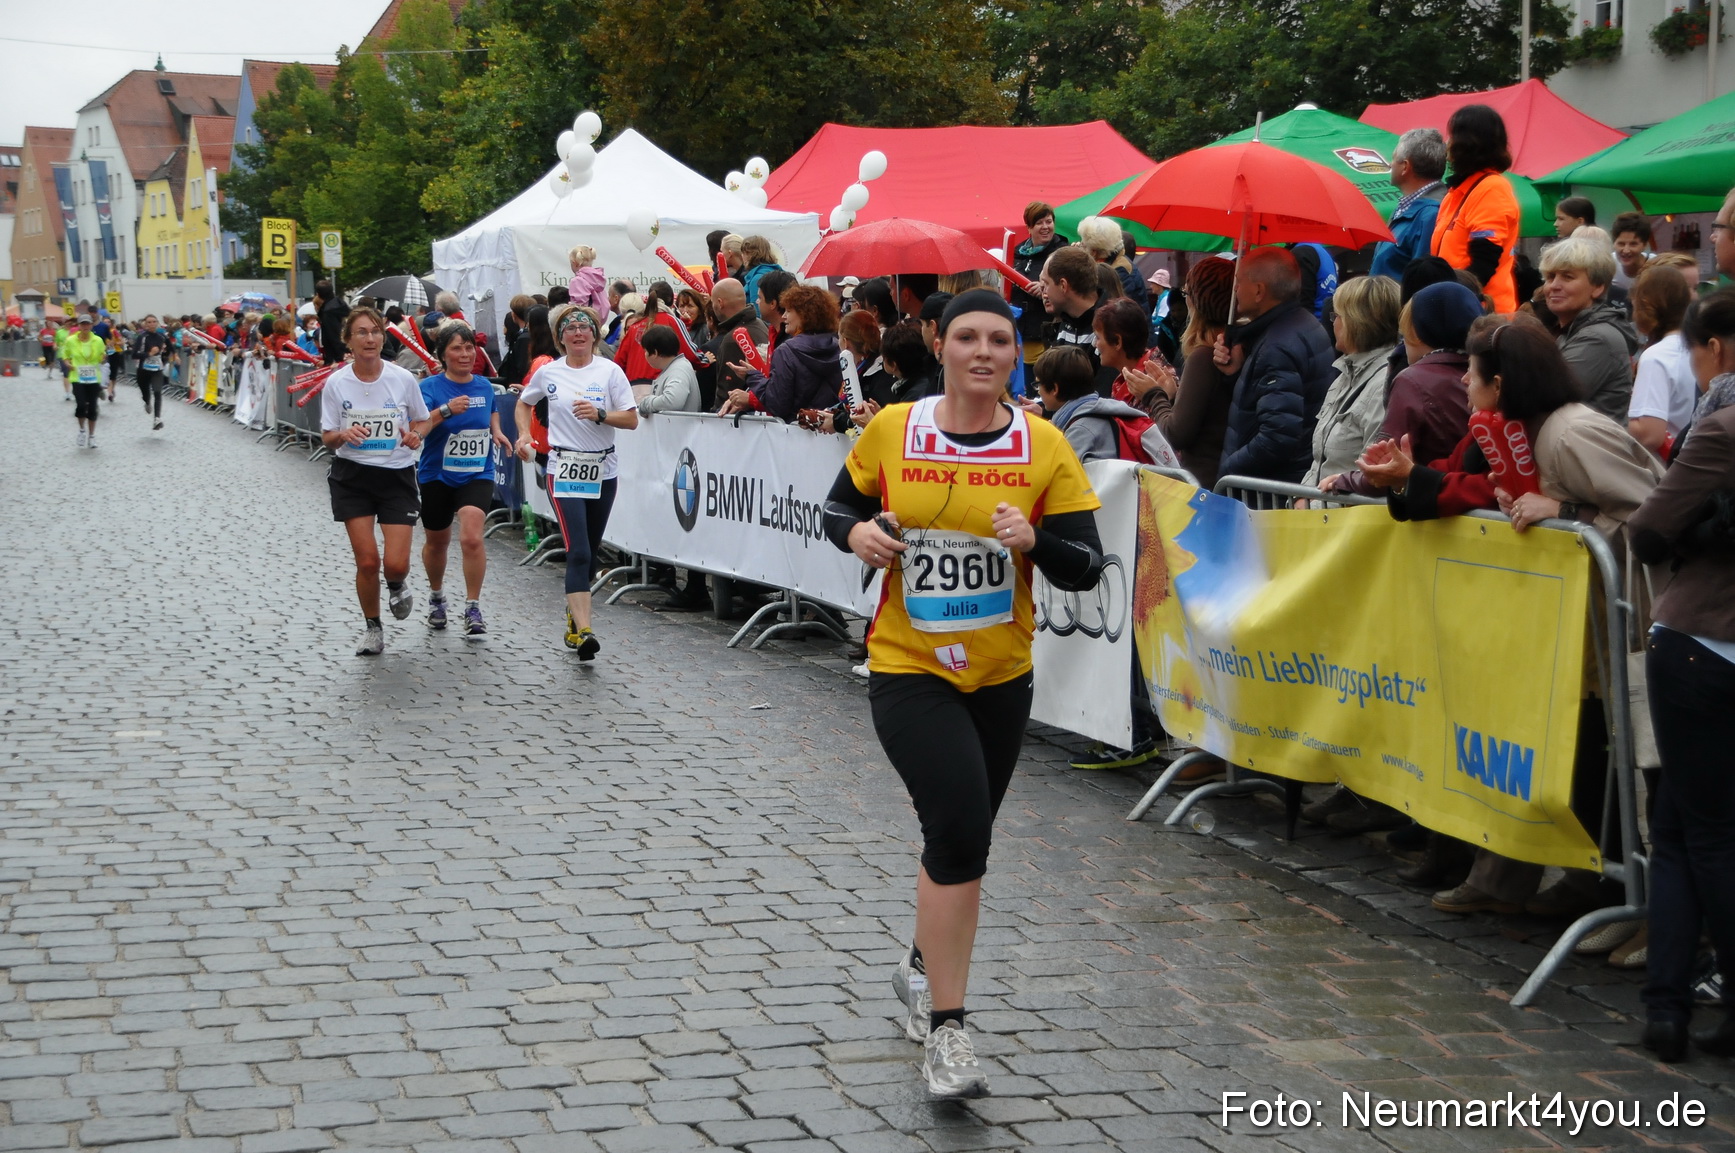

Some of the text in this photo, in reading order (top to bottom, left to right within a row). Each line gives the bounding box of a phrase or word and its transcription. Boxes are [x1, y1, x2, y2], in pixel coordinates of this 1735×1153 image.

[266, 221, 292, 230] Block
[271, 233, 287, 257] B
[449, 440, 484, 456] 2991
[453, 459, 481, 467] Christine
[559, 463, 599, 481] 2680
[901, 467, 1031, 487] MAX BÖGL
[569, 483, 585, 491] Karin
[706, 472, 756, 523] BMW
[914, 553, 1005, 592] 2960
[942, 601, 979, 617] Julia
[1267, 725, 1299, 742] Stufen
[1301, 731, 1361, 758] Gartenmauern
[1452, 720, 1535, 802] KANN
